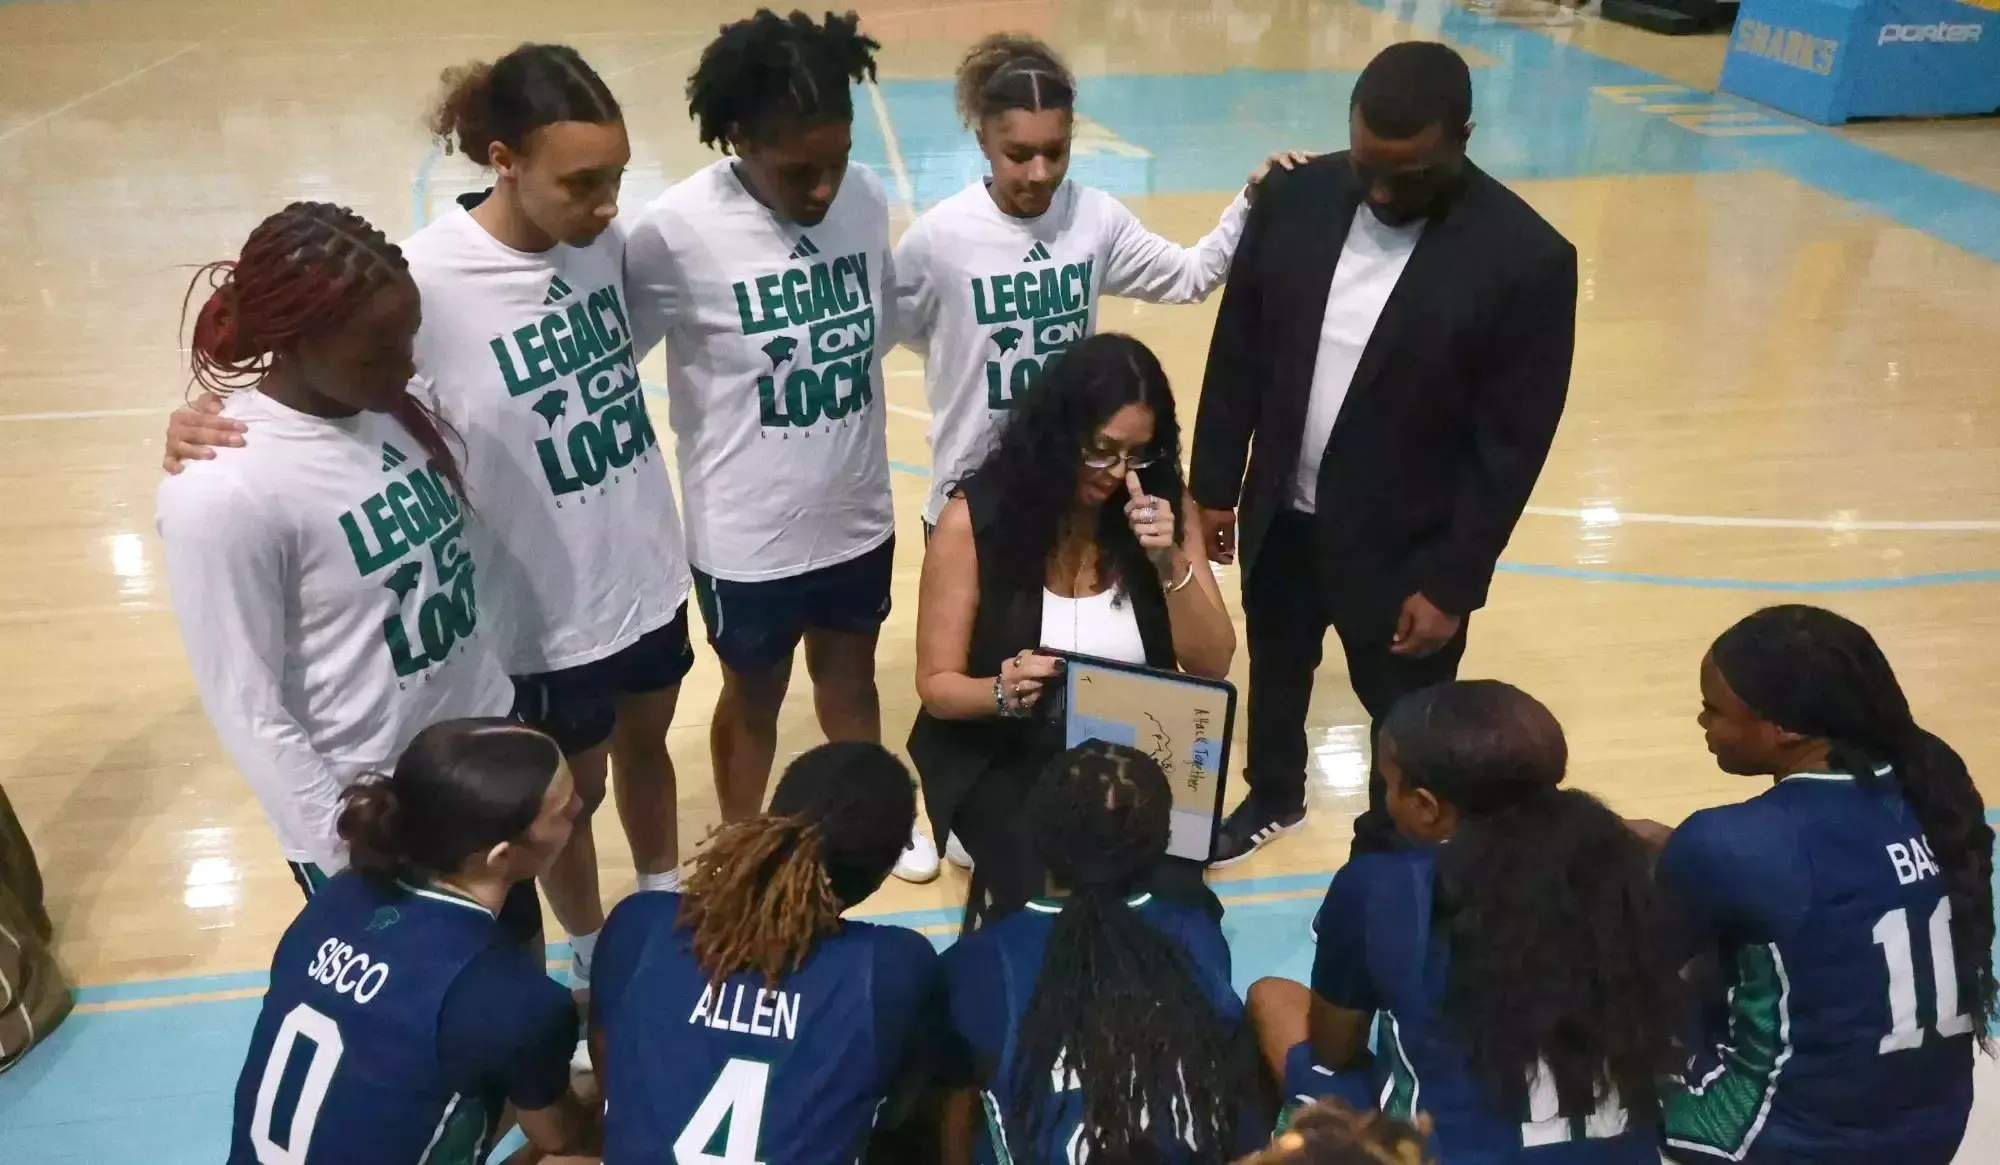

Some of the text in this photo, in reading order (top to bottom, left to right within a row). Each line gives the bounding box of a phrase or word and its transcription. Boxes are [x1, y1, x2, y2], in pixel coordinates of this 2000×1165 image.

[1735, 18, 1839, 76] SHARKS
[732, 252, 873, 335] LEGACY
[971, 259, 1094, 325] LEGACY
[1040, 318, 1084, 345] ON
[489, 284, 632, 397] LEGACY
[818, 318, 870, 353] ON
[588, 355, 637, 399] ON
[757, 348, 873, 427] LOCK
[535, 387, 656, 496] LOCK
[338, 459, 461, 577] LEGAC
[383, 561, 477, 677] LOC
[308, 937, 389, 1004] SISCO
[689, 982, 800, 1040] ALLEN
[250, 1002, 344, 1165] 0
[673, 1057, 770, 1165] 4
